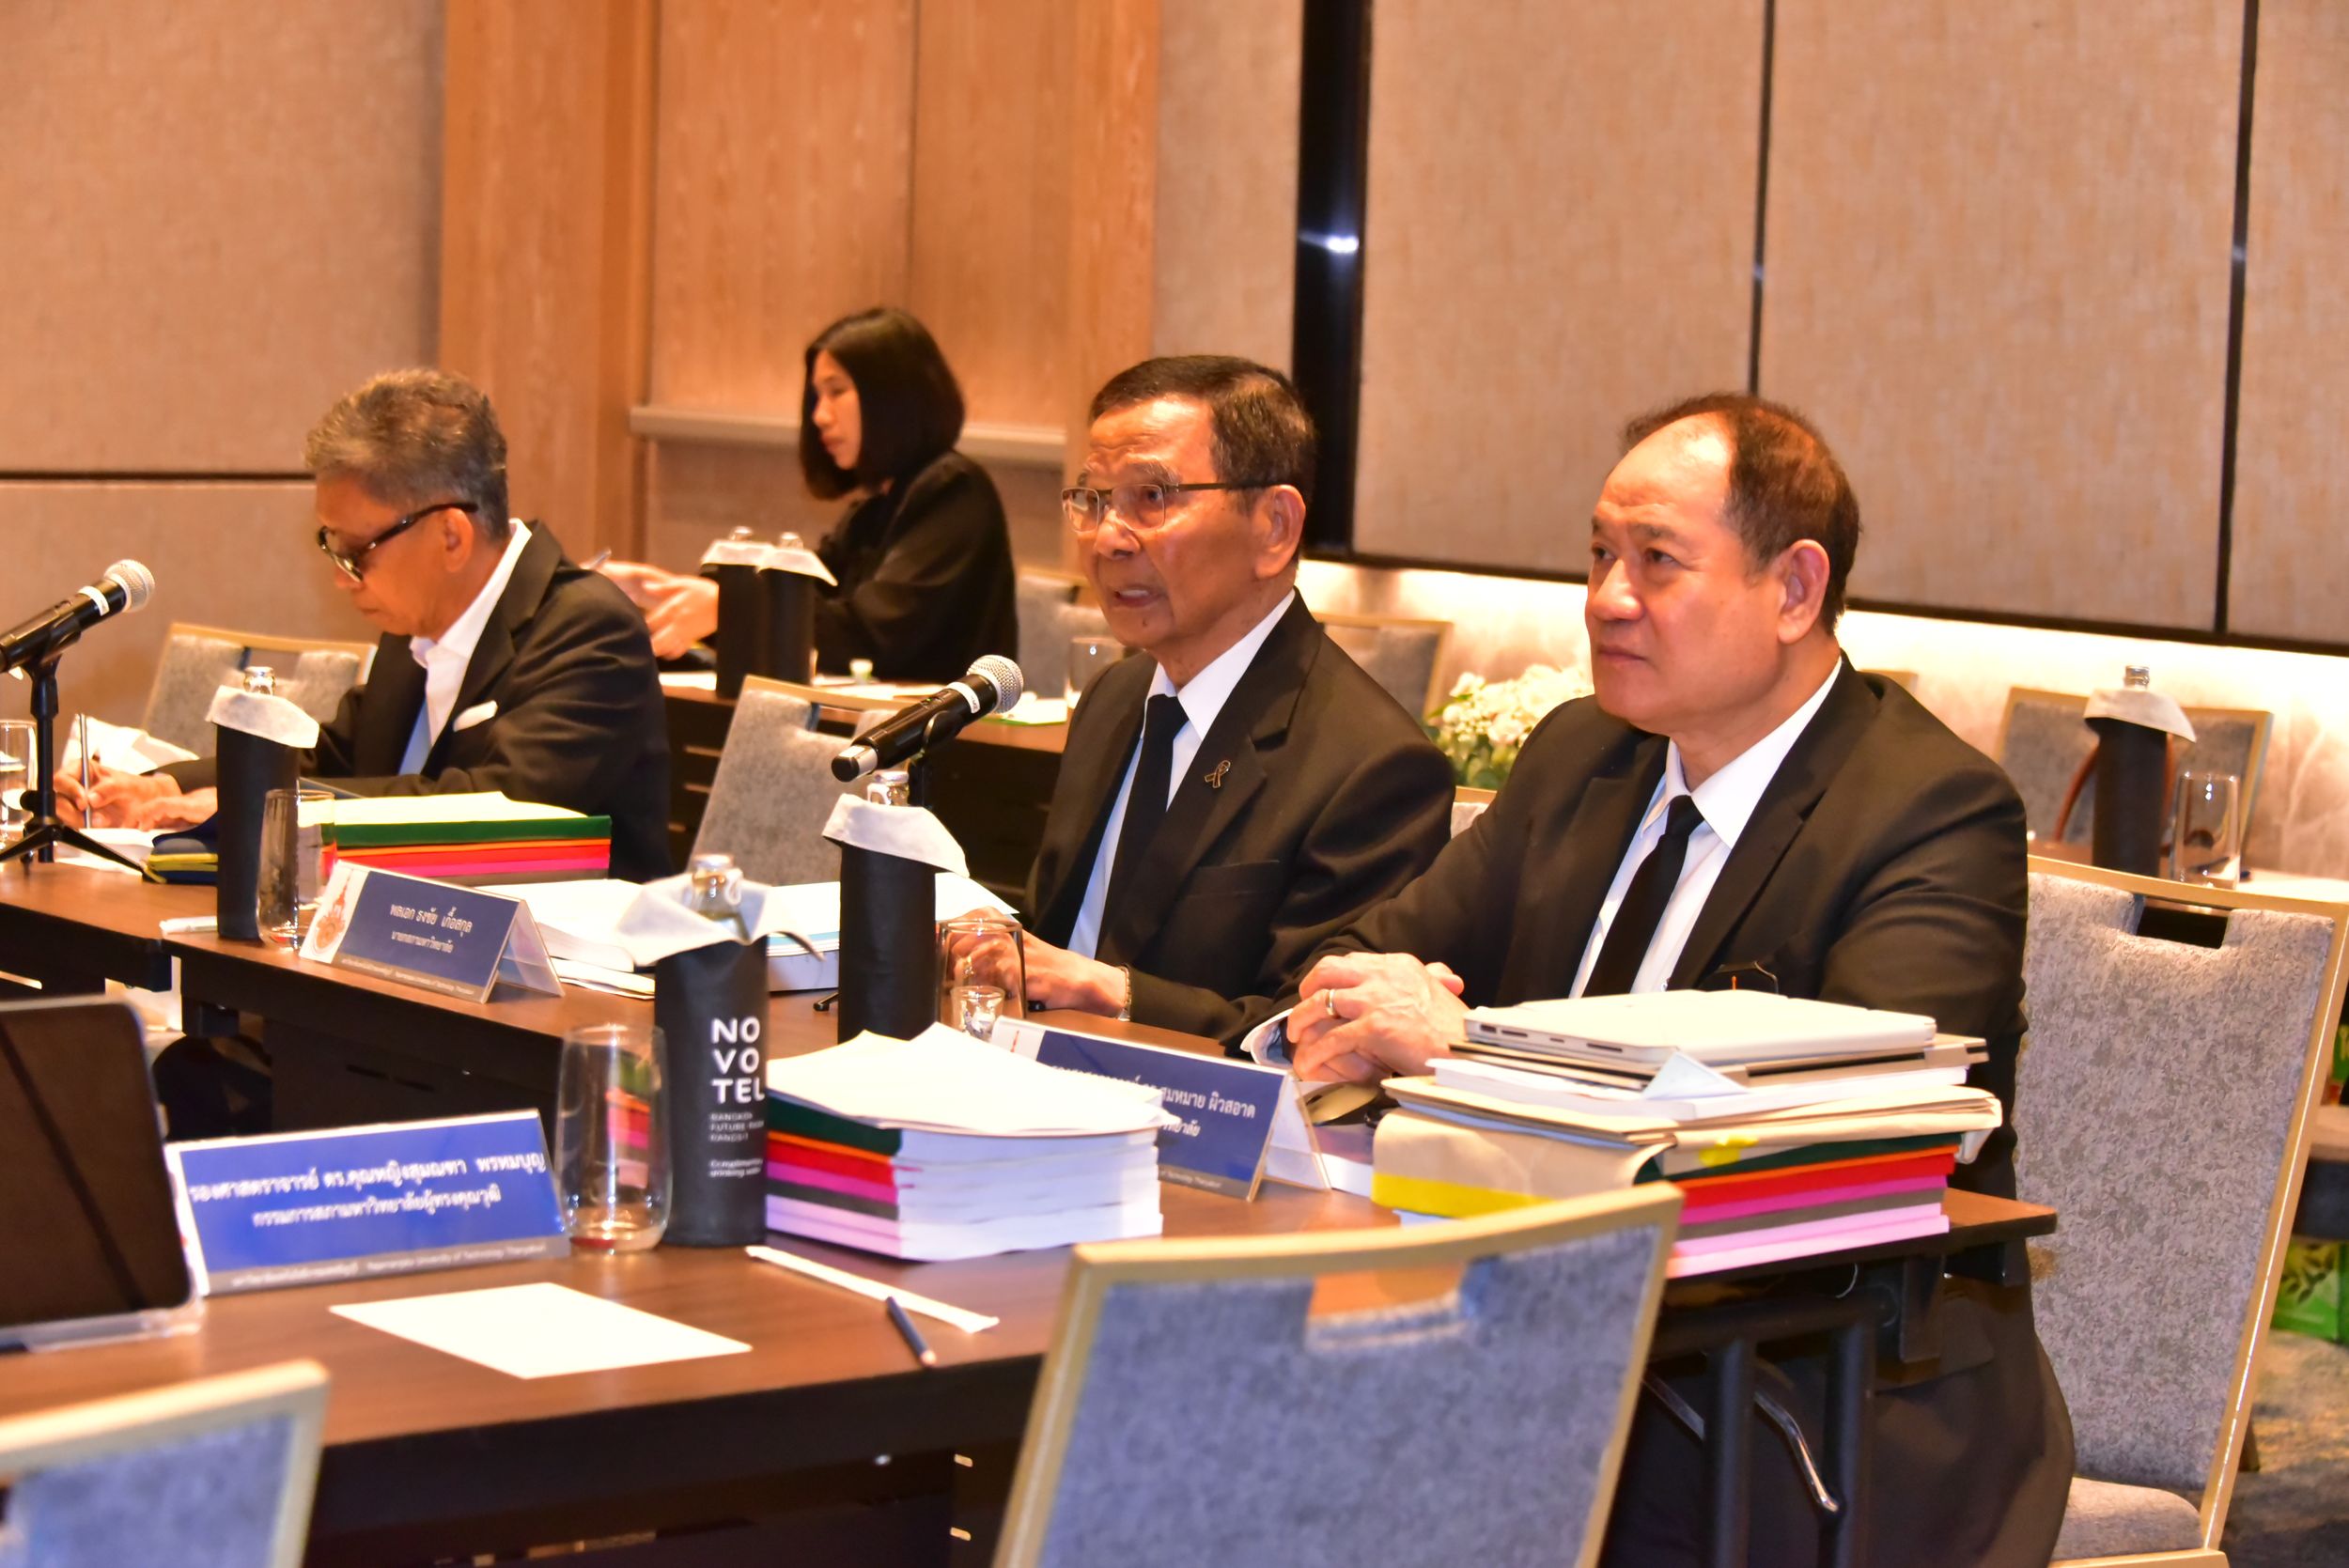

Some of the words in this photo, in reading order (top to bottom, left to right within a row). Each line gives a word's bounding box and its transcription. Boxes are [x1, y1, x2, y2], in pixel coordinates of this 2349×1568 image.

[416, 907, 439, 925] ธงชัย
[710, 1017, 761, 1045] NO
[711, 1047, 760, 1075] VO
[710, 1077, 766, 1104] TEL
[1208, 1090, 1256, 1119] ผิวสอาด
